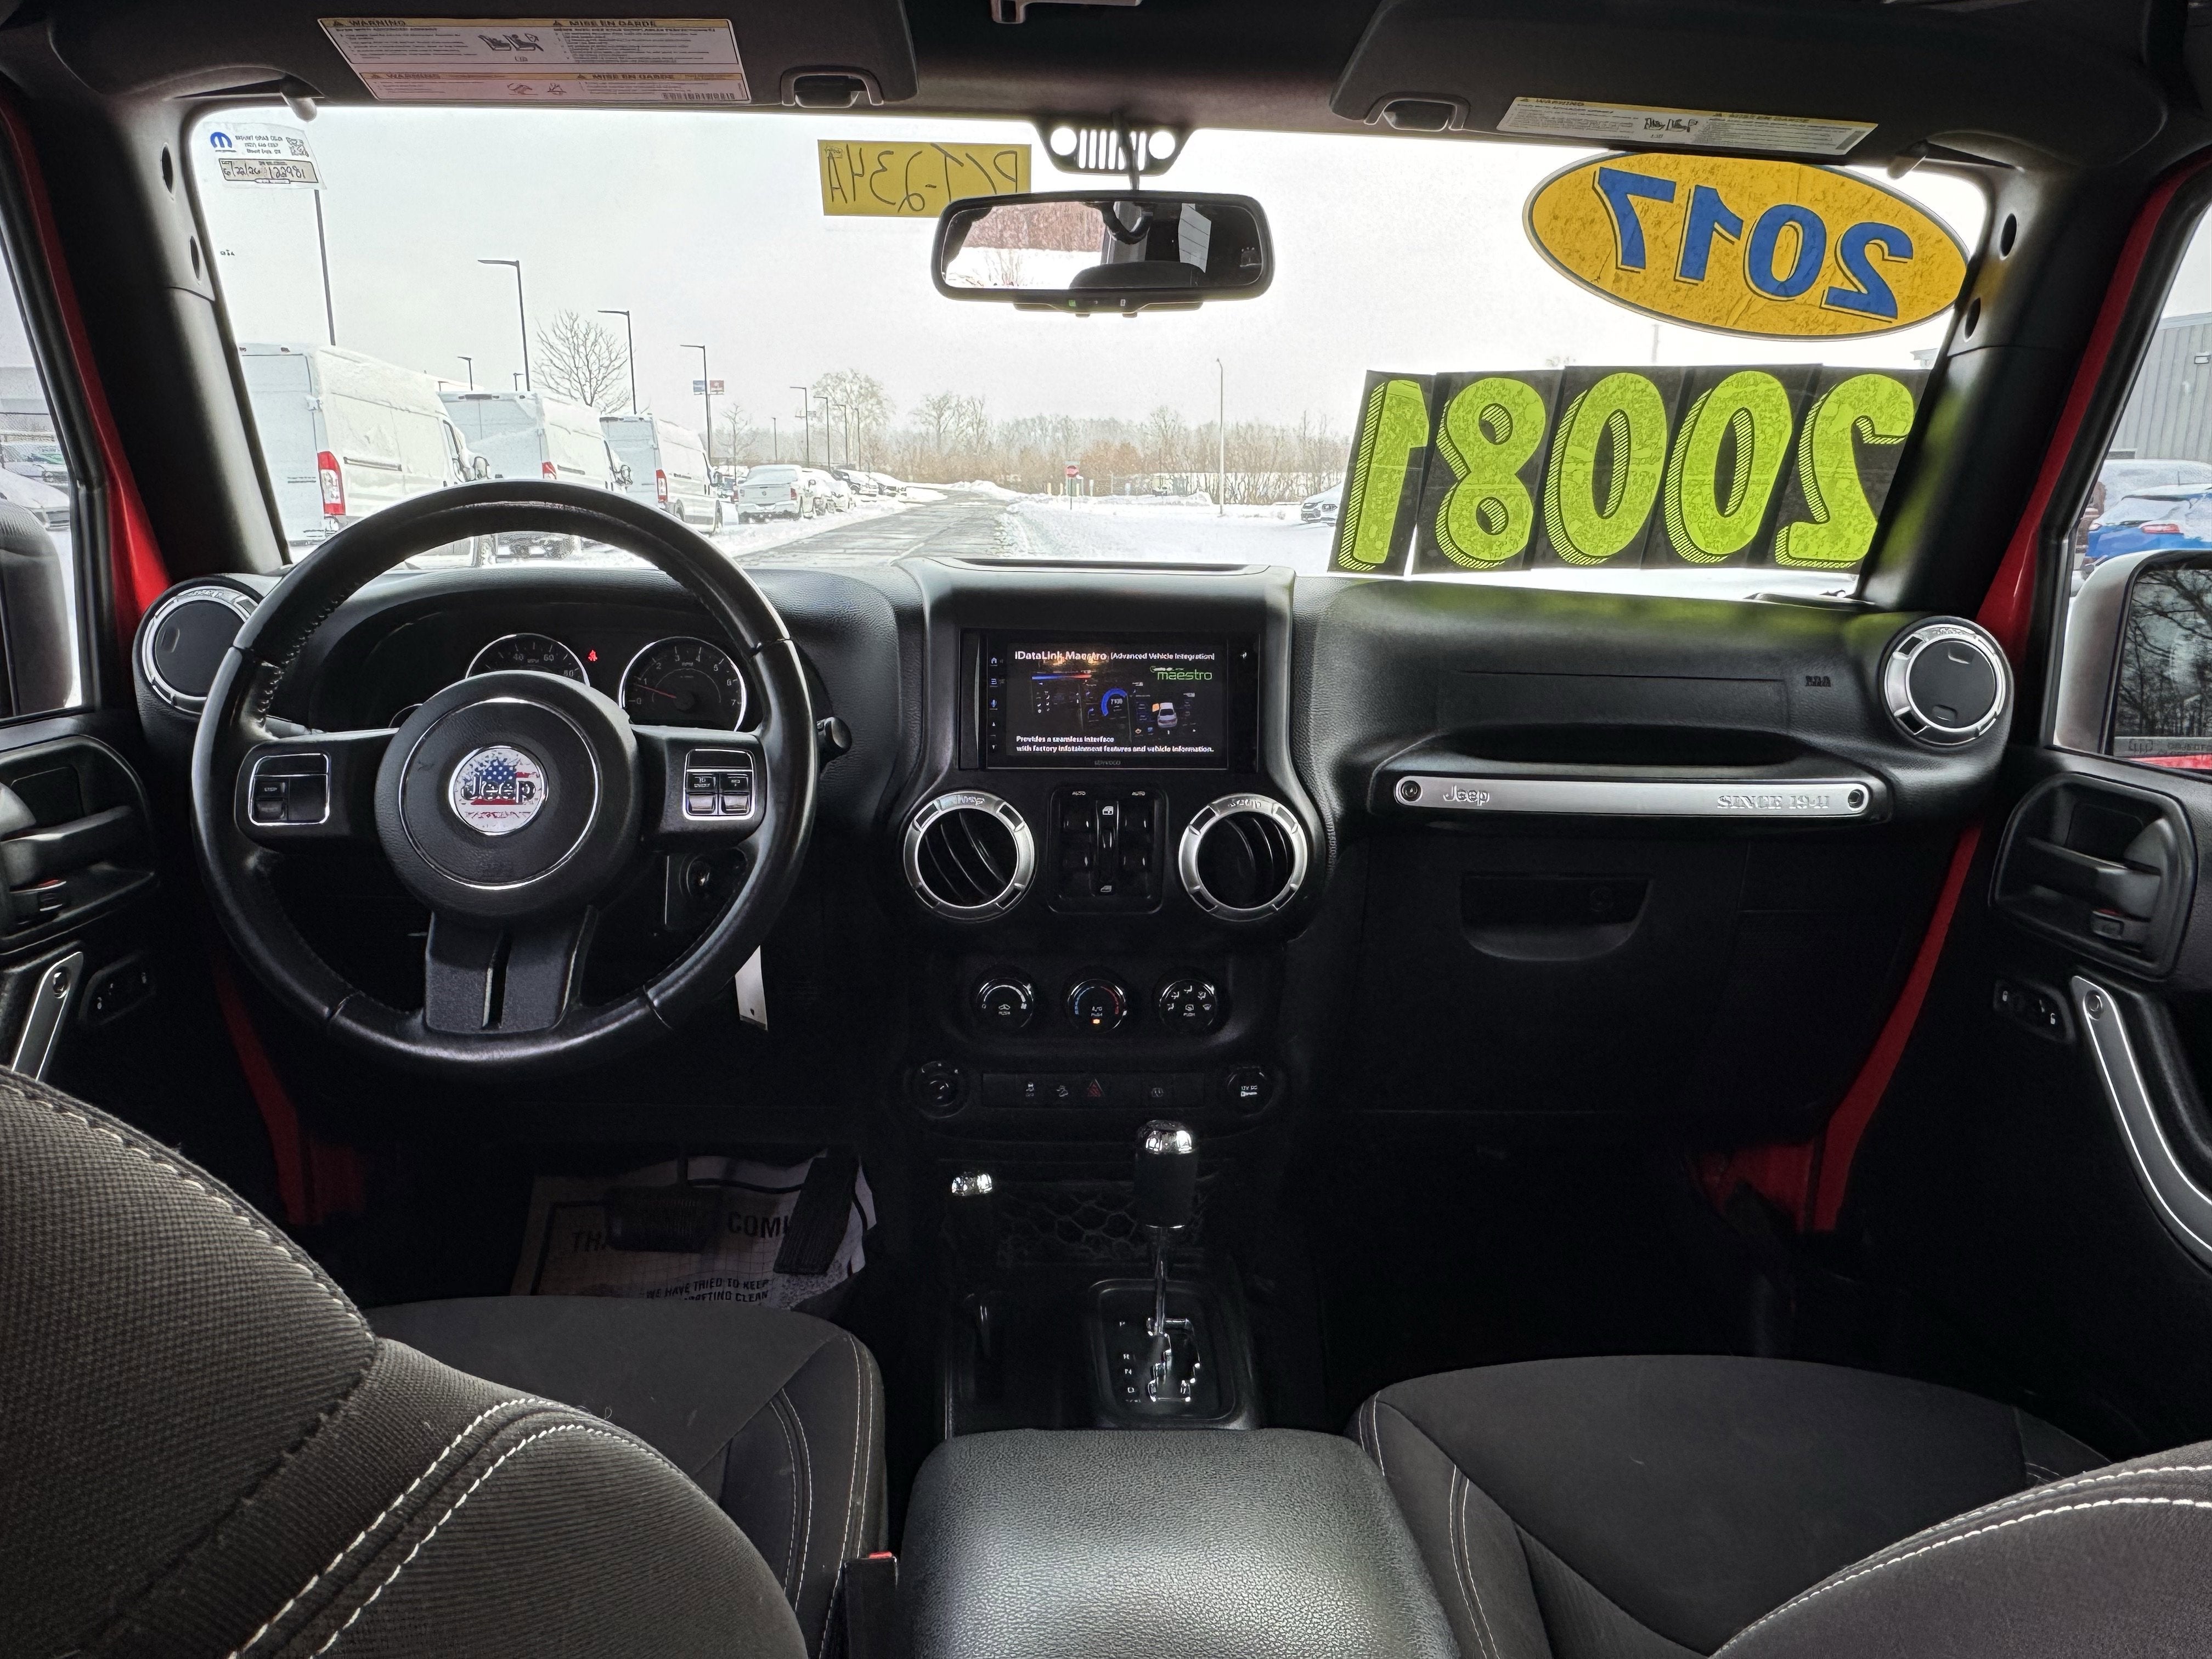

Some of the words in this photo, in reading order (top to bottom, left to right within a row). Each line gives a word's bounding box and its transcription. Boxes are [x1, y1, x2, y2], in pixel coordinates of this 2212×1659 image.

[1065, 651, 1108, 660] Maestro
[1157, 670, 1212, 680] maestro
[1032, 745, 1057, 753] factory
[461, 775, 535, 804] Jeep
[1443, 785, 1490, 806] Jeep
[1717, 795, 1783, 809] SINCE
[1788, 795, 1830, 809] 1941
[646, 1289, 661, 1299] WE
[664, 1283, 690, 1297] HAVE
[693, 1277, 723, 1291] TRIED
[727, 1278, 740, 1288] TO
[743, 1279, 769, 1290] KEEP
[735, 1290, 769, 1302] CLEAN
